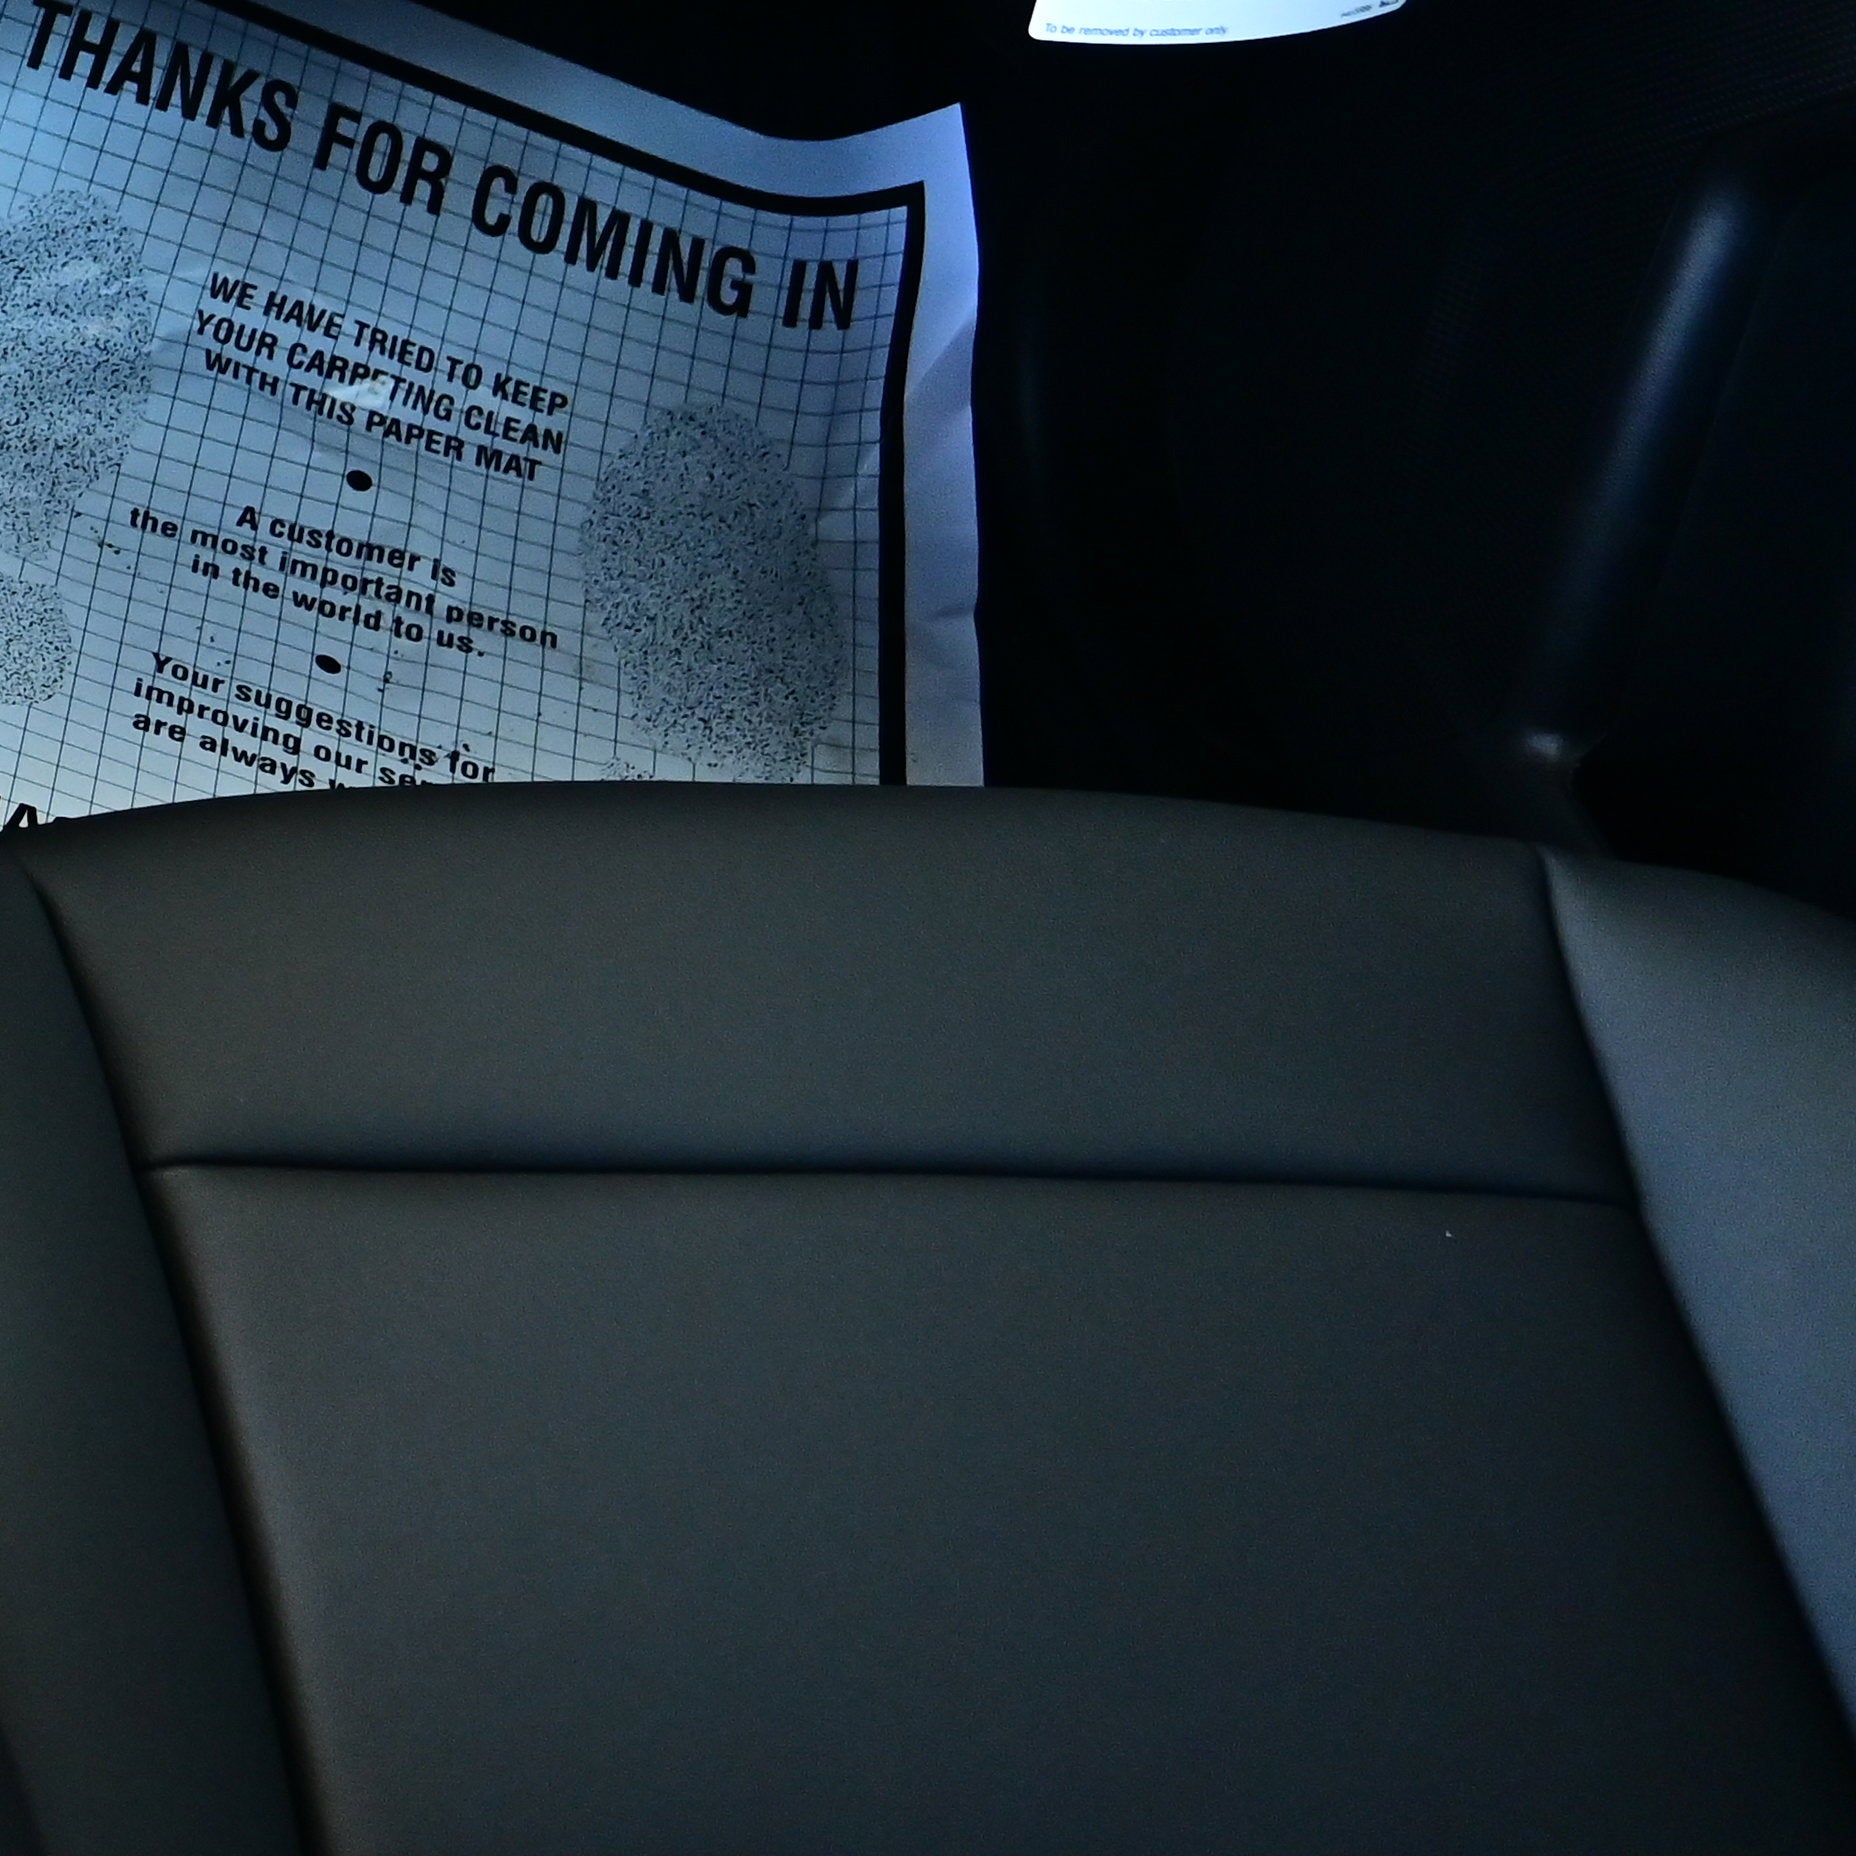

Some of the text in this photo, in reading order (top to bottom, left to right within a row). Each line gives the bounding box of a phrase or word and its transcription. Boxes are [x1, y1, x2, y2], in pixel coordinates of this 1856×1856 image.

[1045, 23, 1229, 37] To be removed by customer only
[314, 101, 452, 216] FOR
[472, 164, 756, 318] COMING
[782, 259, 859, 331] IN
[195, 309, 279, 361] YOUR
[464, 404, 564, 455] CLEAN
[208, 271, 569, 417] WE HAVE TRIED TO KEEP
[204, 348, 542, 482] WITH THIS PAPER MAT
[129, 507, 558, 650] the most important person
[190, 553, 486, 657] in the world to us.
[235, 505, 457, 588] A customer is
[133, 713, 316, 789] are always
[134, 678, 370, 774] improving our
[152, 652, 496, 783] Your suggestions for
